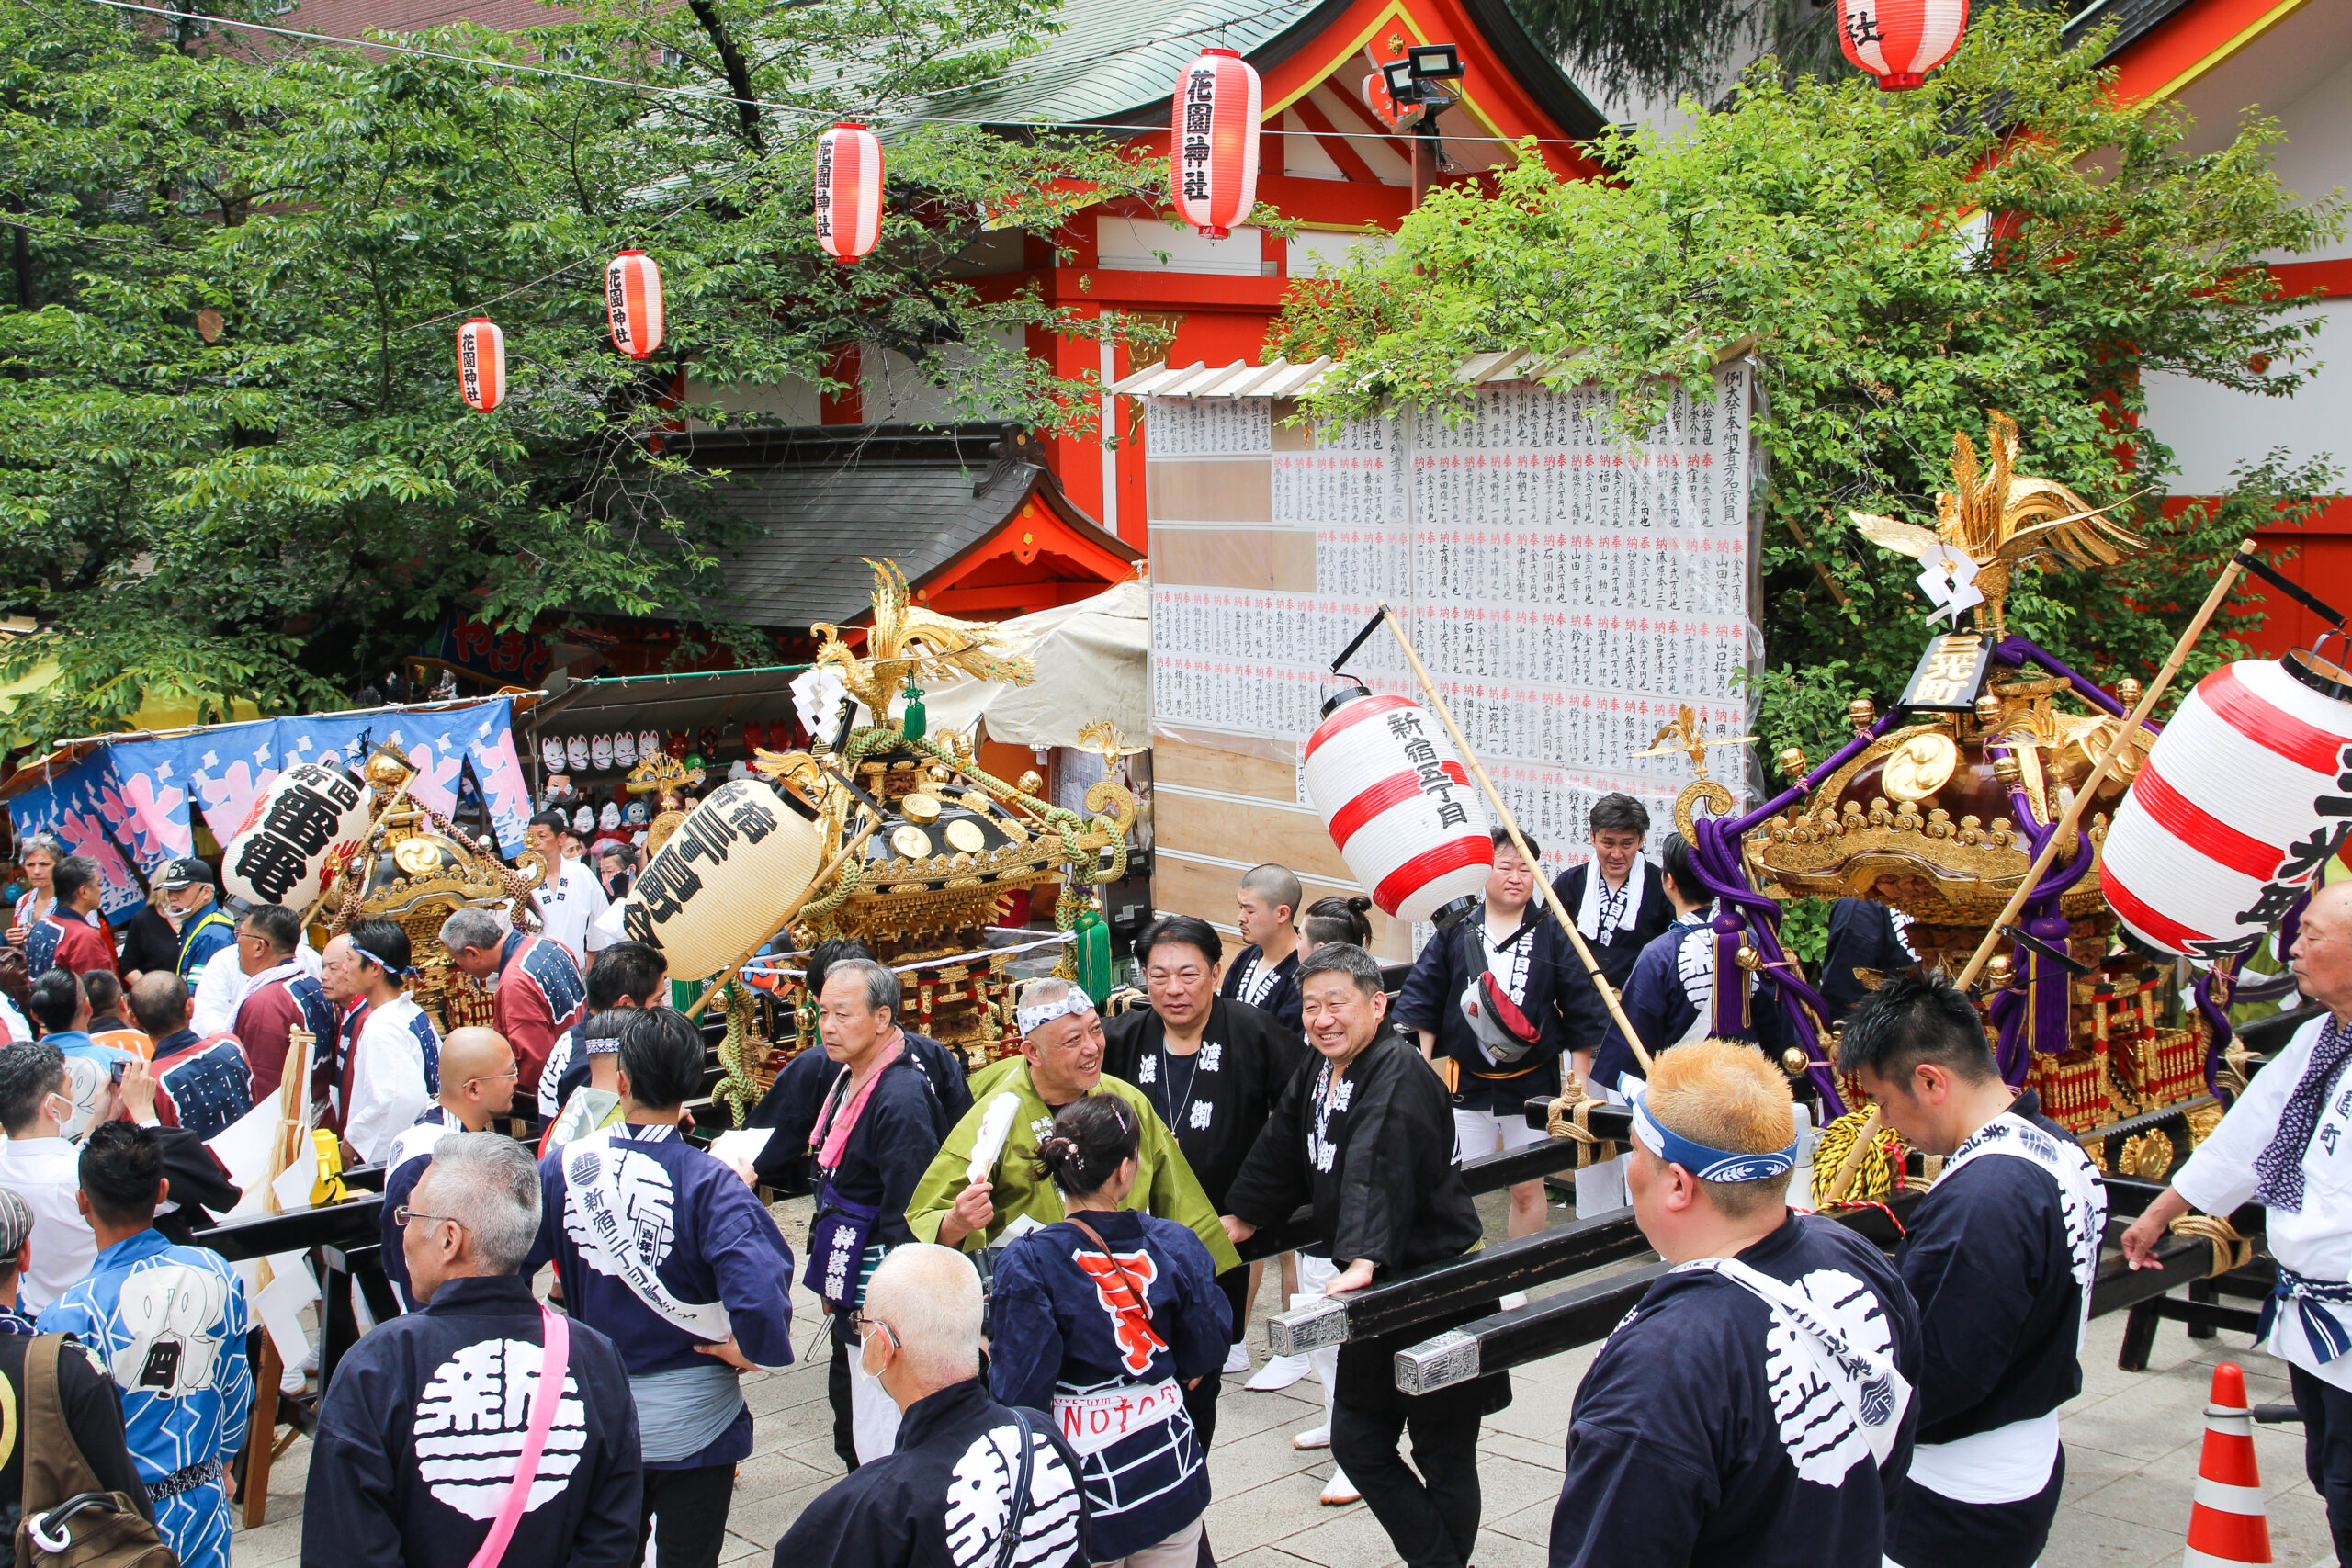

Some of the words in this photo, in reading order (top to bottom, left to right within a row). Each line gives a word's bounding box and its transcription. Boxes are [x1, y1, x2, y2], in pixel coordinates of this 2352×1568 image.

[1845, 11, 1885, 50] 社
[1183, 70, 1215, 201] 花園神社
[817, 140, 831, 238] 花園神社
[608, 268, 630, 344] 花園神社
[461, 333, 480, 401] 花園神社
[1388, 402, 1408, 524] 祭奉納者芳名(一般)
[1386, 711, 1468, 829] 新宿五丁目
